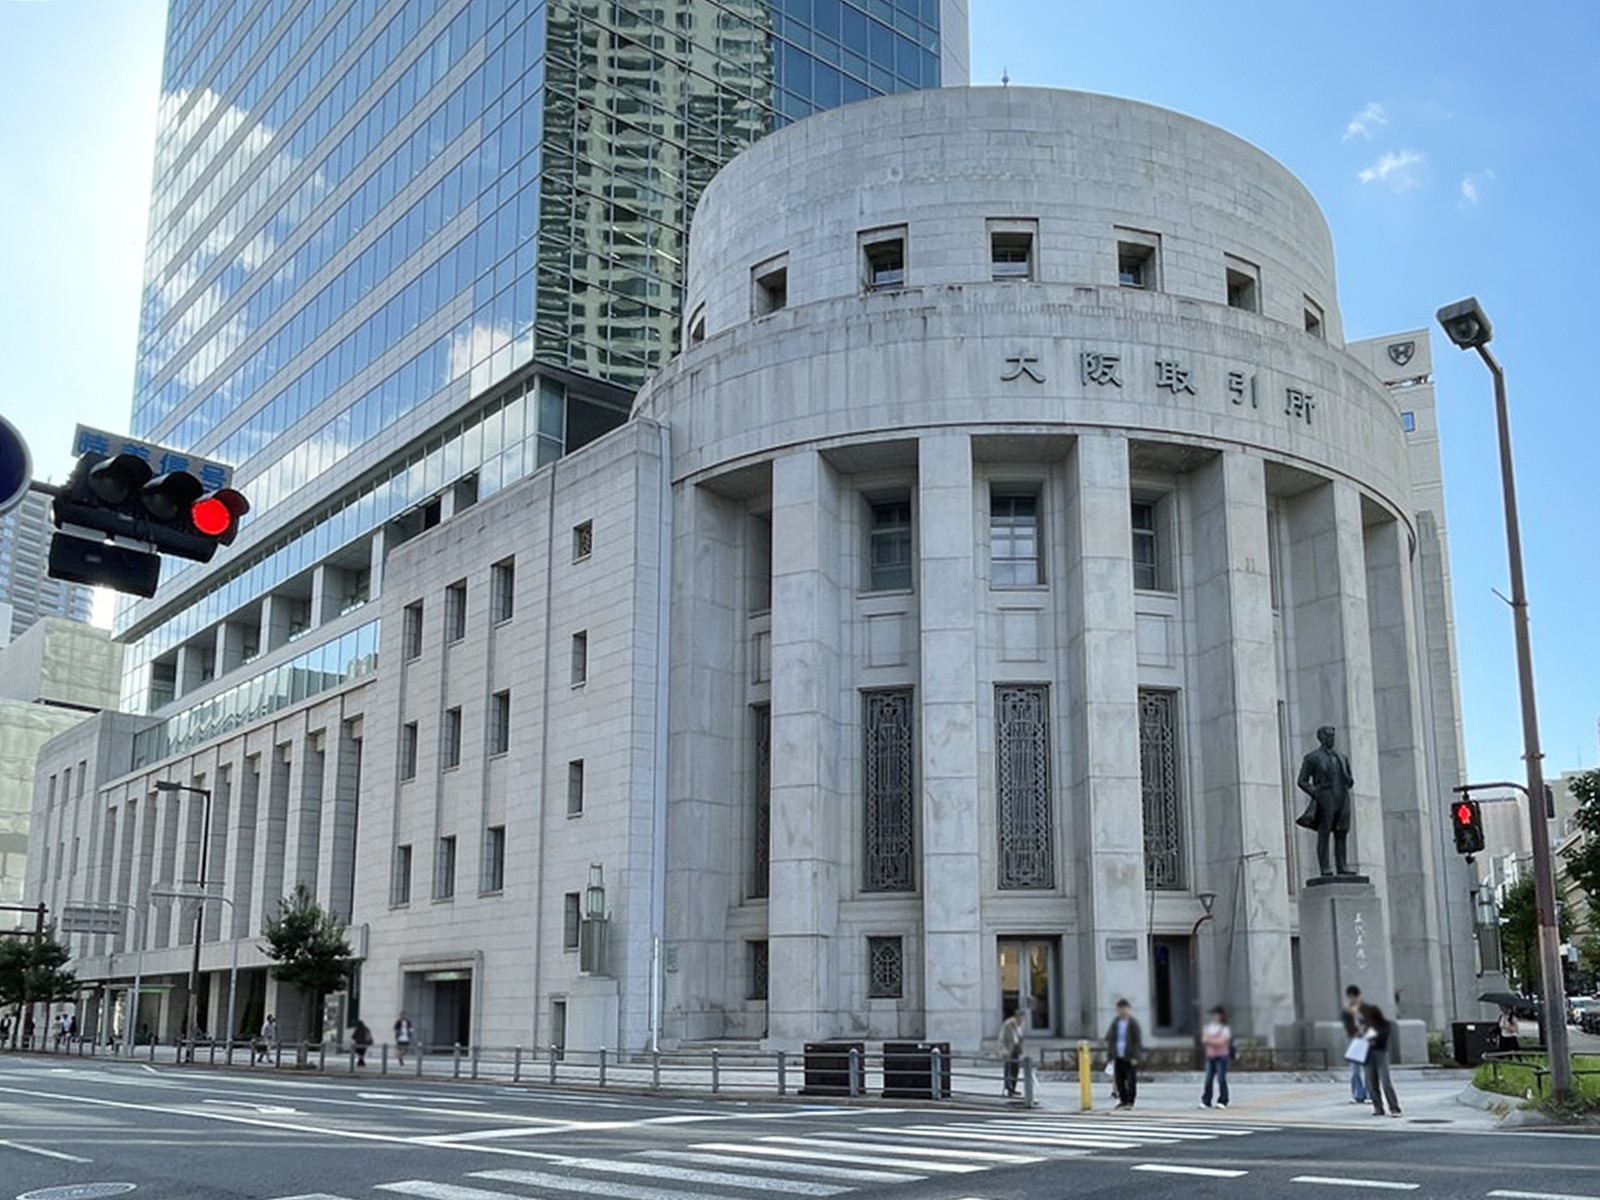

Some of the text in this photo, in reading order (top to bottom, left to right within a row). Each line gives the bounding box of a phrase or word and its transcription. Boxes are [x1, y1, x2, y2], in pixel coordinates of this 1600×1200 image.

[1001, 351, 1315, 424] 大阪取引所
